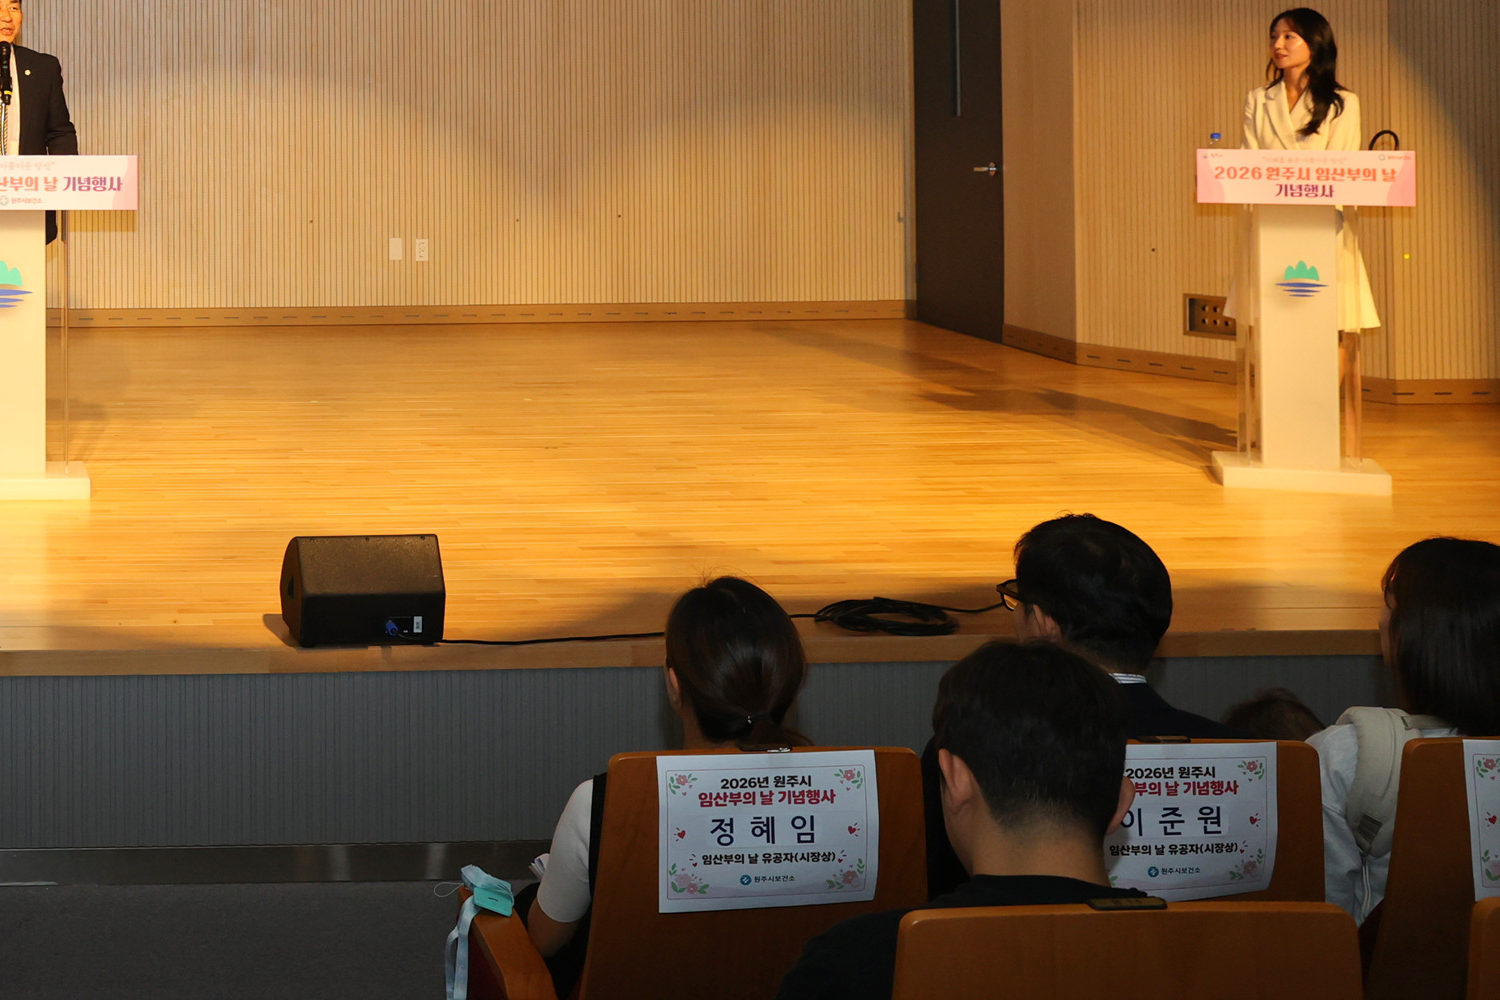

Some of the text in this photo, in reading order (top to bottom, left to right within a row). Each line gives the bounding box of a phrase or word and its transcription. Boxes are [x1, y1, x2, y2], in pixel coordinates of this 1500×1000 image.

[1214, 166, 1396, 182] 2026 원주시 임산부의 날
[44, 176, 58, 192] 날
[62, 176, 123, 192] 기념행사
[1276, 184, 1334, 198] 기념행사
[1126, 766, 1215, 779] 2026년 원주시
[721, 775, 811, 789] 2026년 원주시
[1134, 780, 1239, 796] 부의 날 기념행사
[698, 789, 836, 807] 임산부의 날 기념행사
[1110, 842, 1238, 856] 임산부의 날 유공자(시장상)
[702, 852, 836, 865] 임산부의 날 유공자(시장상)
[1161, 866, 1200, 875] 원주시보건소
[754, 875, 795, 883] 원주시보건소
